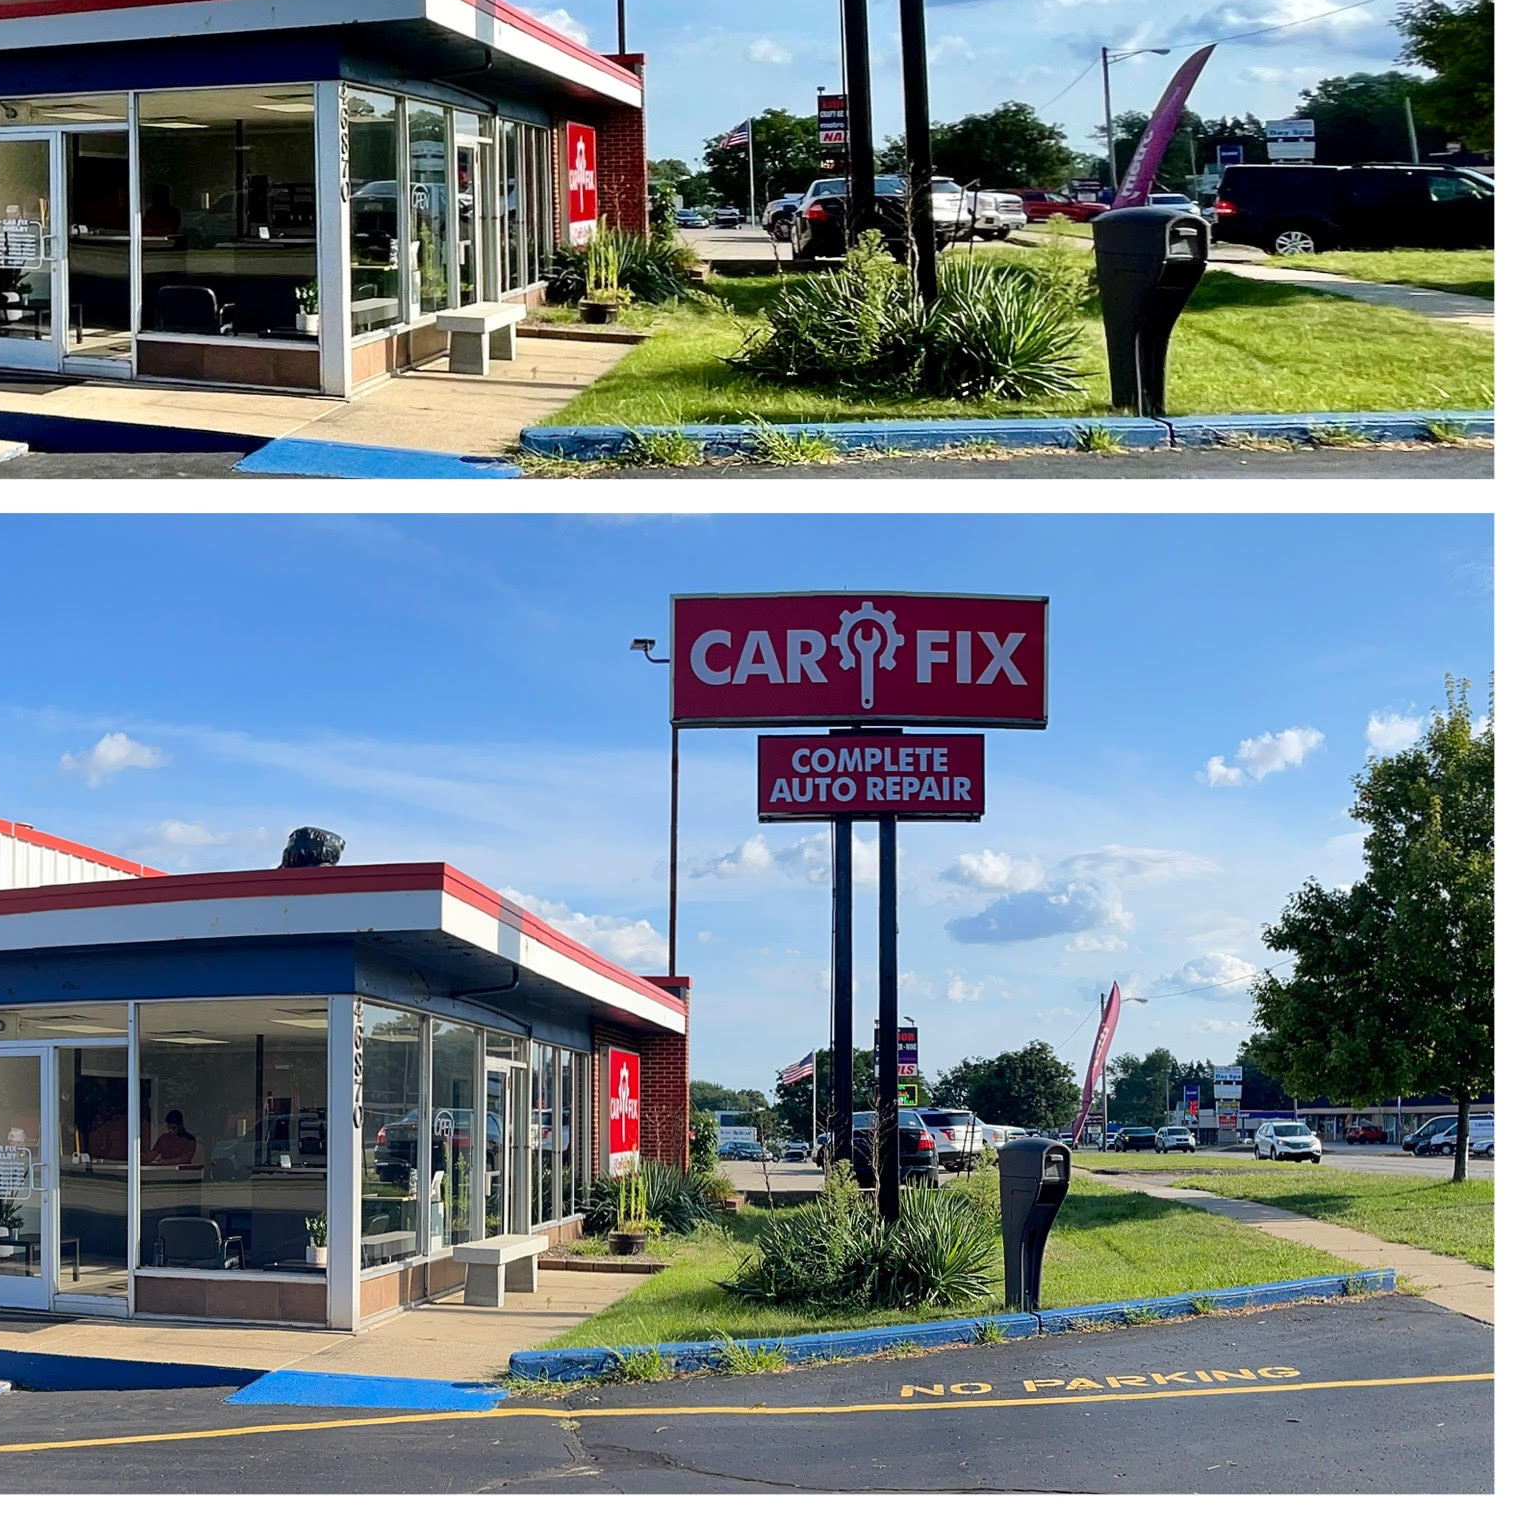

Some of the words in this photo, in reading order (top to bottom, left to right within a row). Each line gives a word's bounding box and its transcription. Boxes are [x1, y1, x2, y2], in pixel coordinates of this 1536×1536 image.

[690, 629, 828, 685] CAR
[916, 629, 1028, 686] FIX
[792, 747, 948, 774] COMPLETE
[769, 776, 857, 802] AUTO
[867, 776, 971, 801] REPAIR
[610, 1097, 620, 1120] CAR
[628, 1098, 639, 1120] FIX
[434, 1118, 454, 1137] OPEN
[900, 1382, 993, 1397] NO
[1023, 1366, 1302, 1392] PARKING
